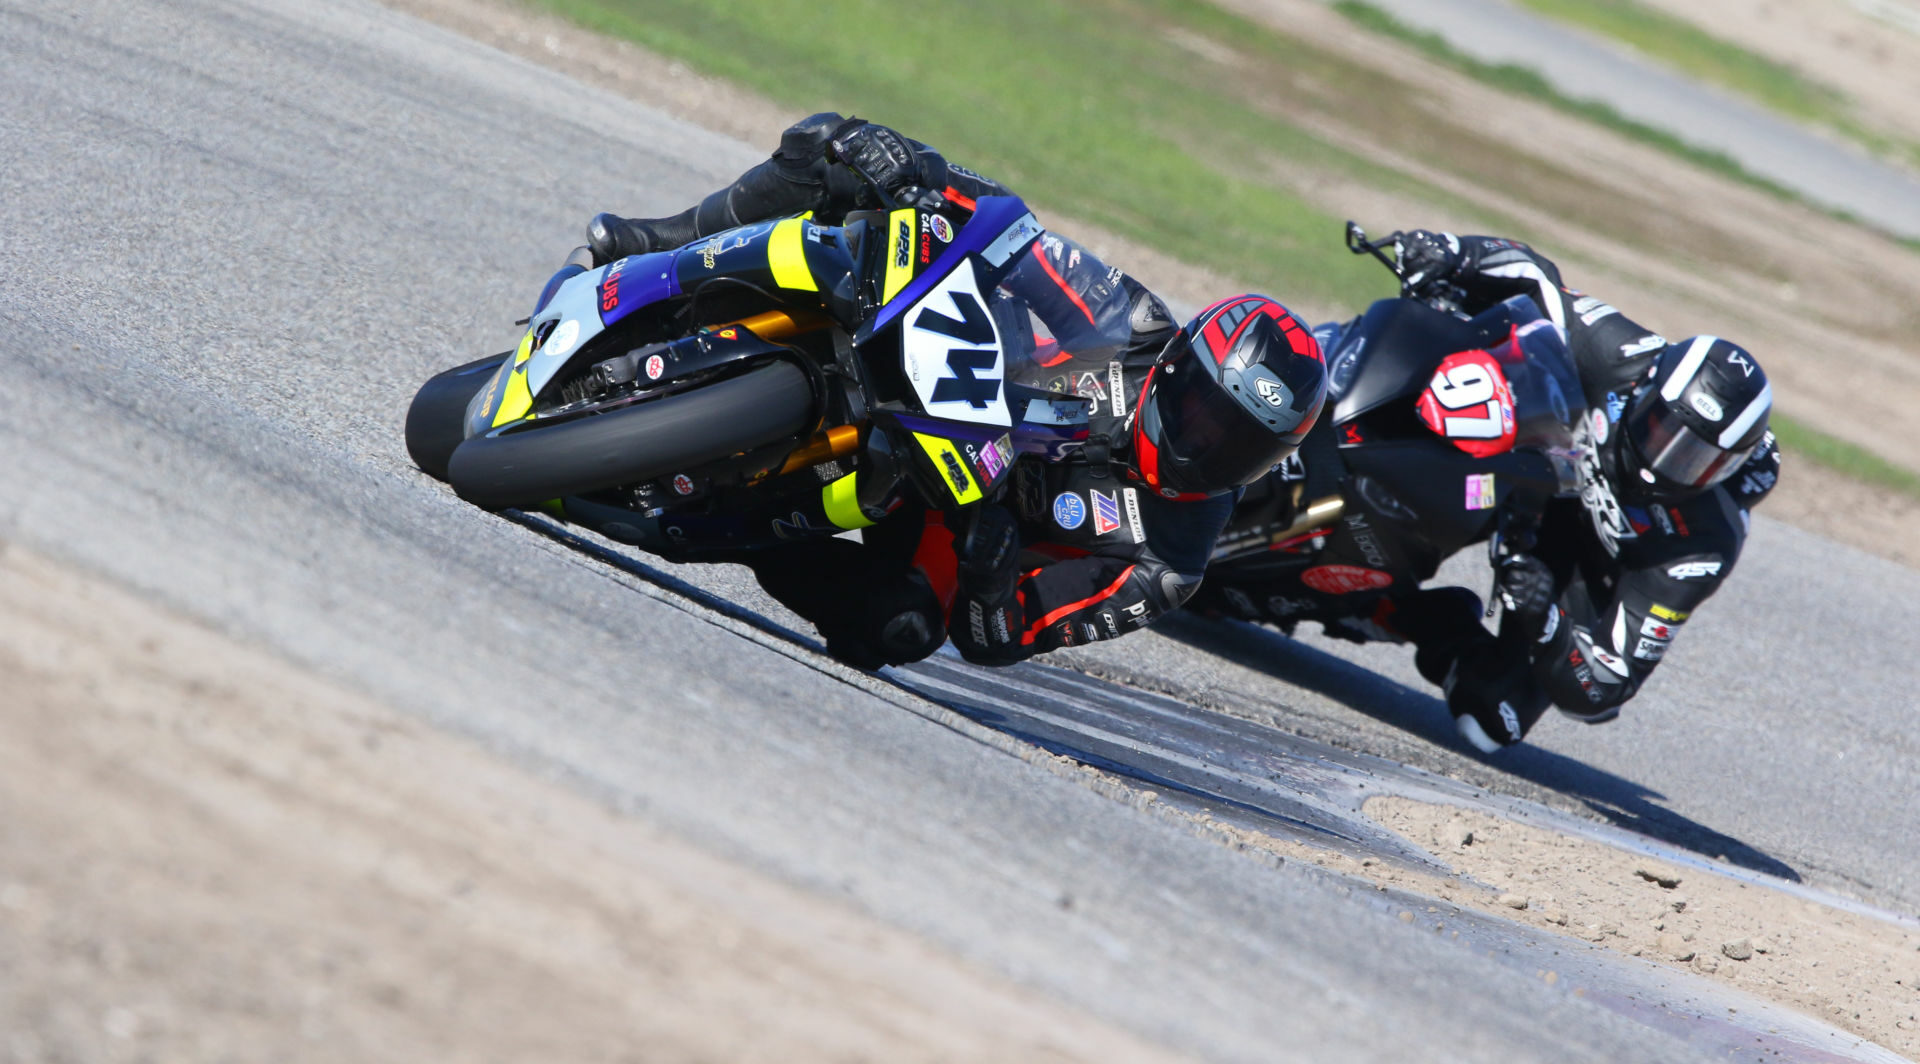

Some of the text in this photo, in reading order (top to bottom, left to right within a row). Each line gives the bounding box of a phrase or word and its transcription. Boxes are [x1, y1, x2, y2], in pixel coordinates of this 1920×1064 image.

[921, 213, 931, 264] CAL CUBS
[602, 257, 629, 311] CAL CUBS
[912, 290, 1002, 410] 74
[1111, 371, 1124, 415] DUNLOP
[1430, 363, 1503, 438] 97
[1696, 398, 1717, 418] BELL
[965, 444, 979, 465] CAL
[976, 460, 993, 488] CUBS
[1127, 498, 1144, 541] DUNLOP
[969, 600, 989, 648] DAINESE
